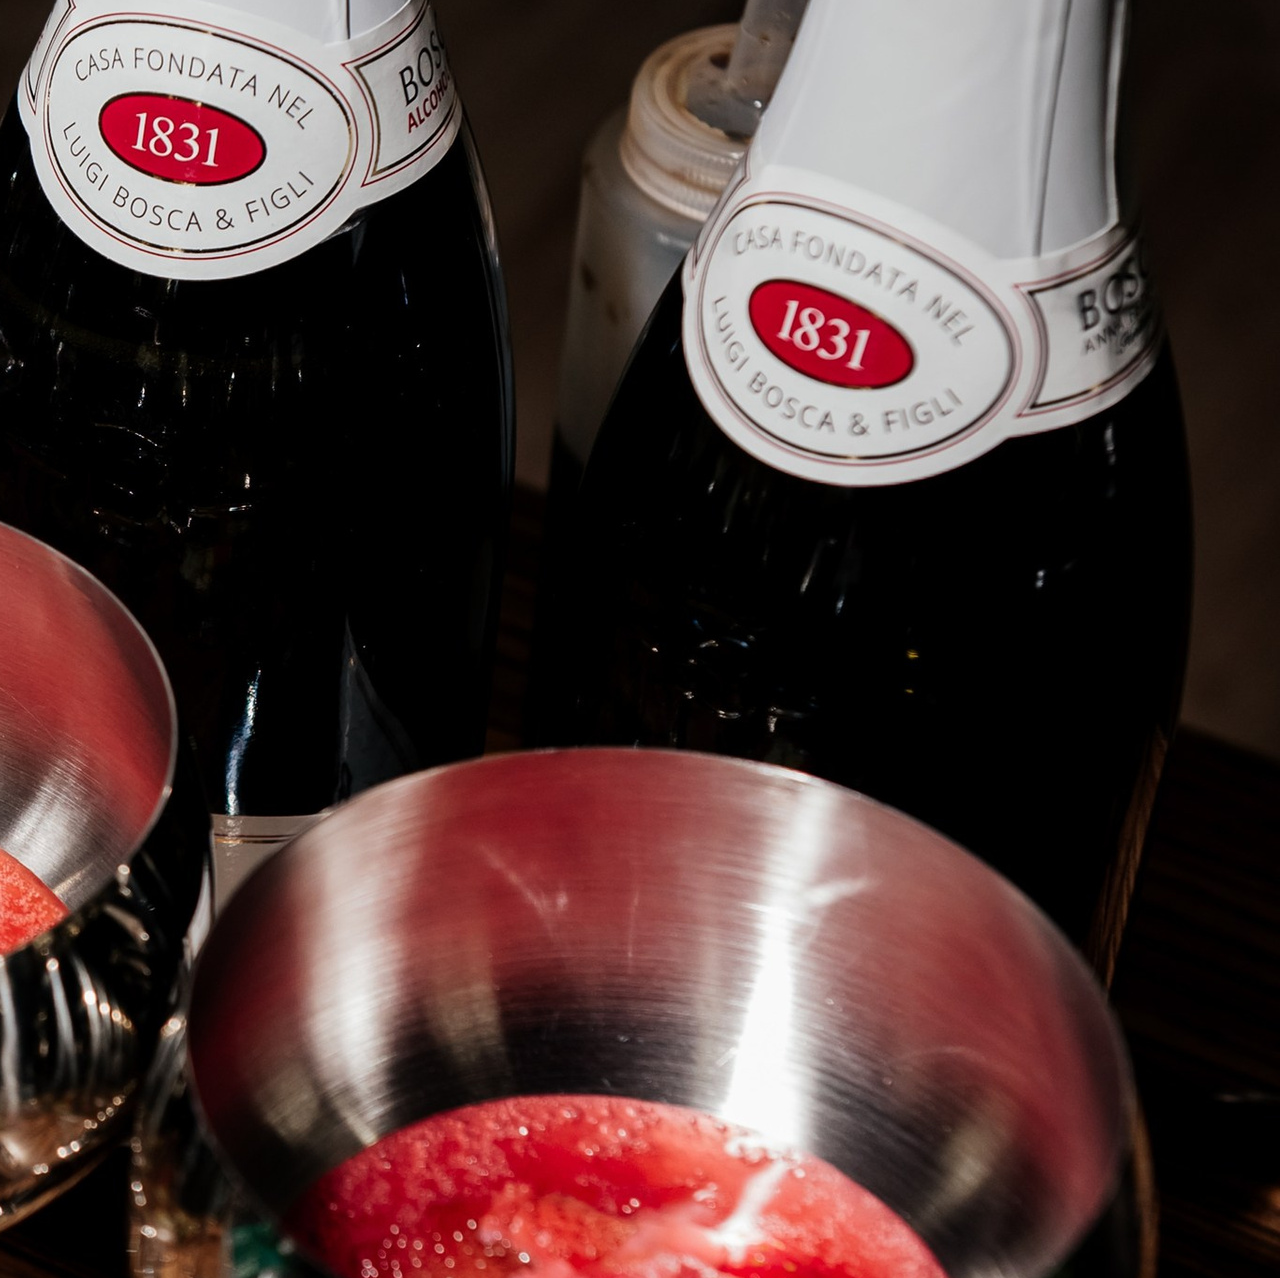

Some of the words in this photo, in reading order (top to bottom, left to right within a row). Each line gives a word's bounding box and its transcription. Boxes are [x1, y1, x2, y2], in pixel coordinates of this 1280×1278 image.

[74, 48, 125, 82] CASA
[133, 48, 258, 97] FONDATA
[267, 83, 314, 130] NEL
[62, 121, 109, 192] LUIGI
[112, 186, 202, 232] BOSCA
[215, 208, 235, 231] &
[245, 170, 314, 223] FIGLI
[131, 112, 220, 167] 1831
[732, 225, 783, 257] CASA
[790, 230, 919, 303] FONDATA
[923, 294, 975, 347] NEL
[712, 295, 750, 373] LUIGI
[747, 371, 835, 433] BOSCA
[847, 412, 870, 436] &
[881, 388, 963, 433] FIGLI
[776, 299, 871, 371] 1831
